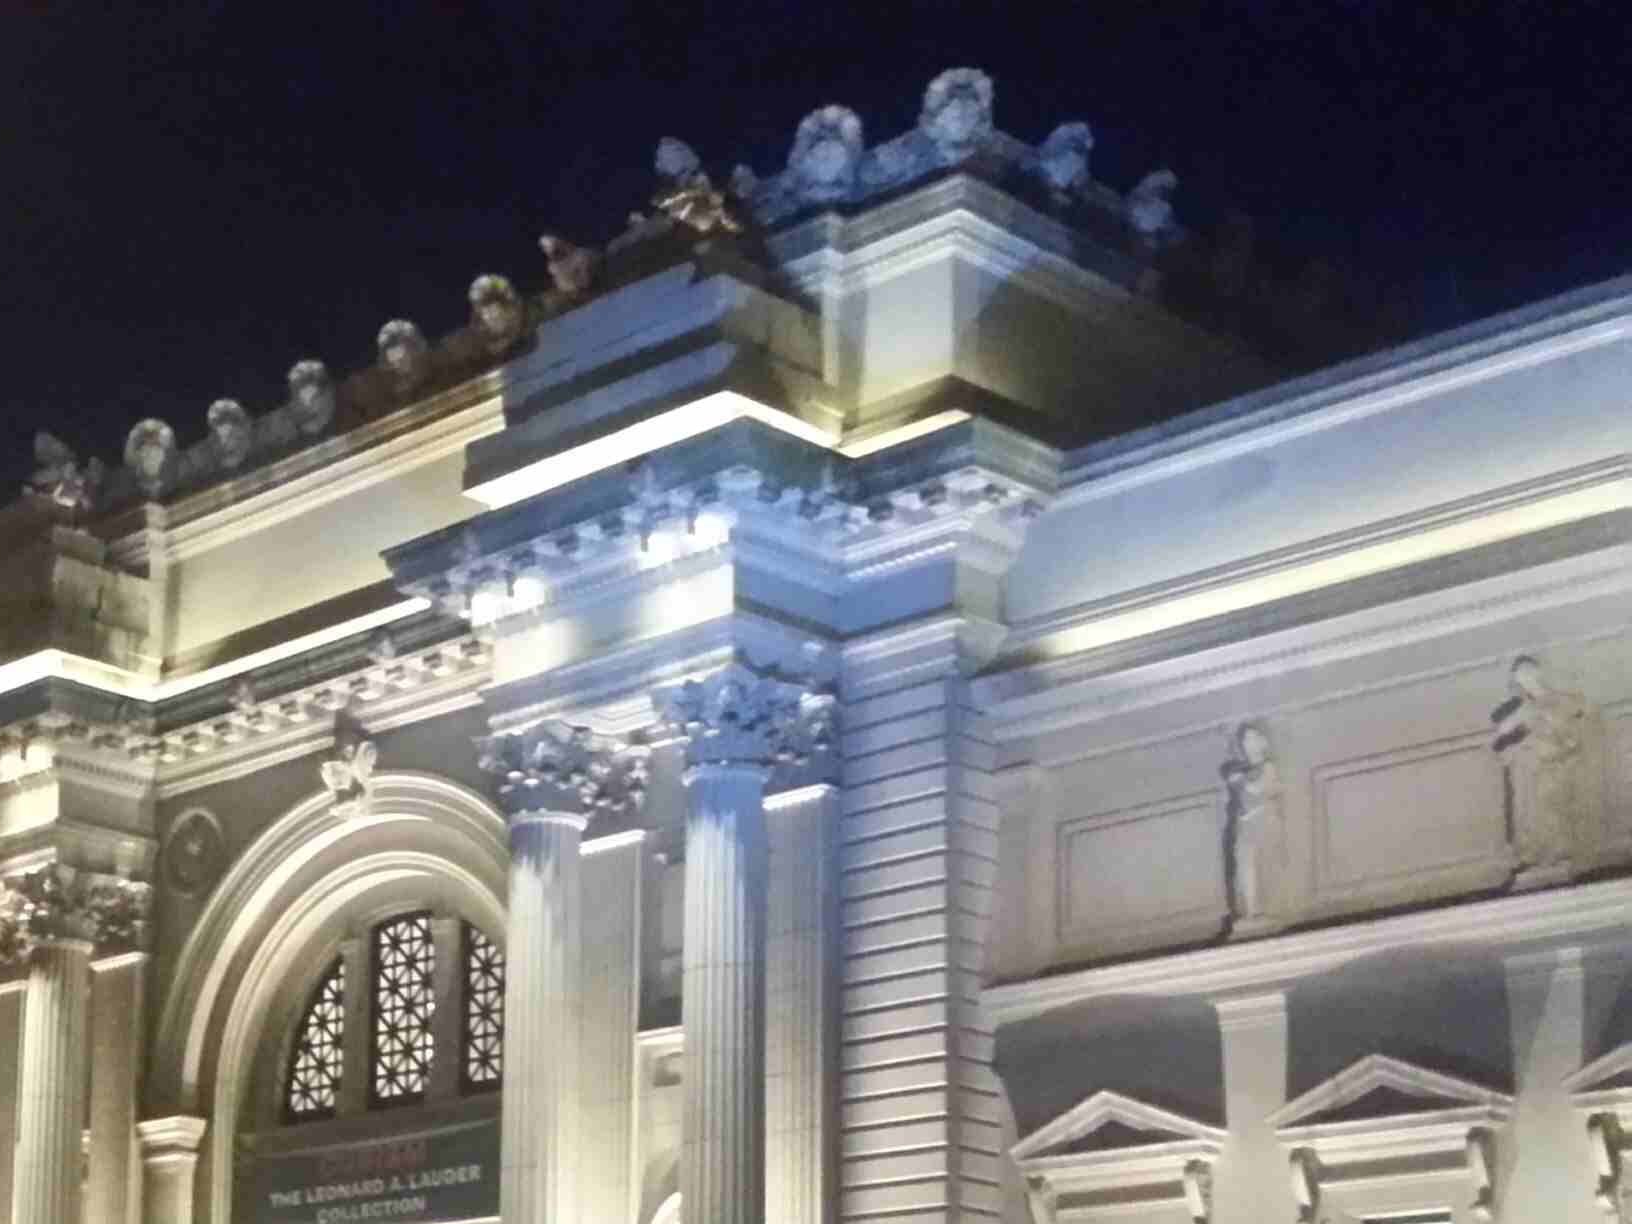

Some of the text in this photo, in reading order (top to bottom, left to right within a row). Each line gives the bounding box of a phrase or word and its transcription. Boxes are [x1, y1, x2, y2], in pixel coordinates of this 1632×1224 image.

[270, 1191, 301, 1207] THE
[306, 1179, 384, 1203] LEONARD
[409, 1165, 482, 1188] LAUDER
